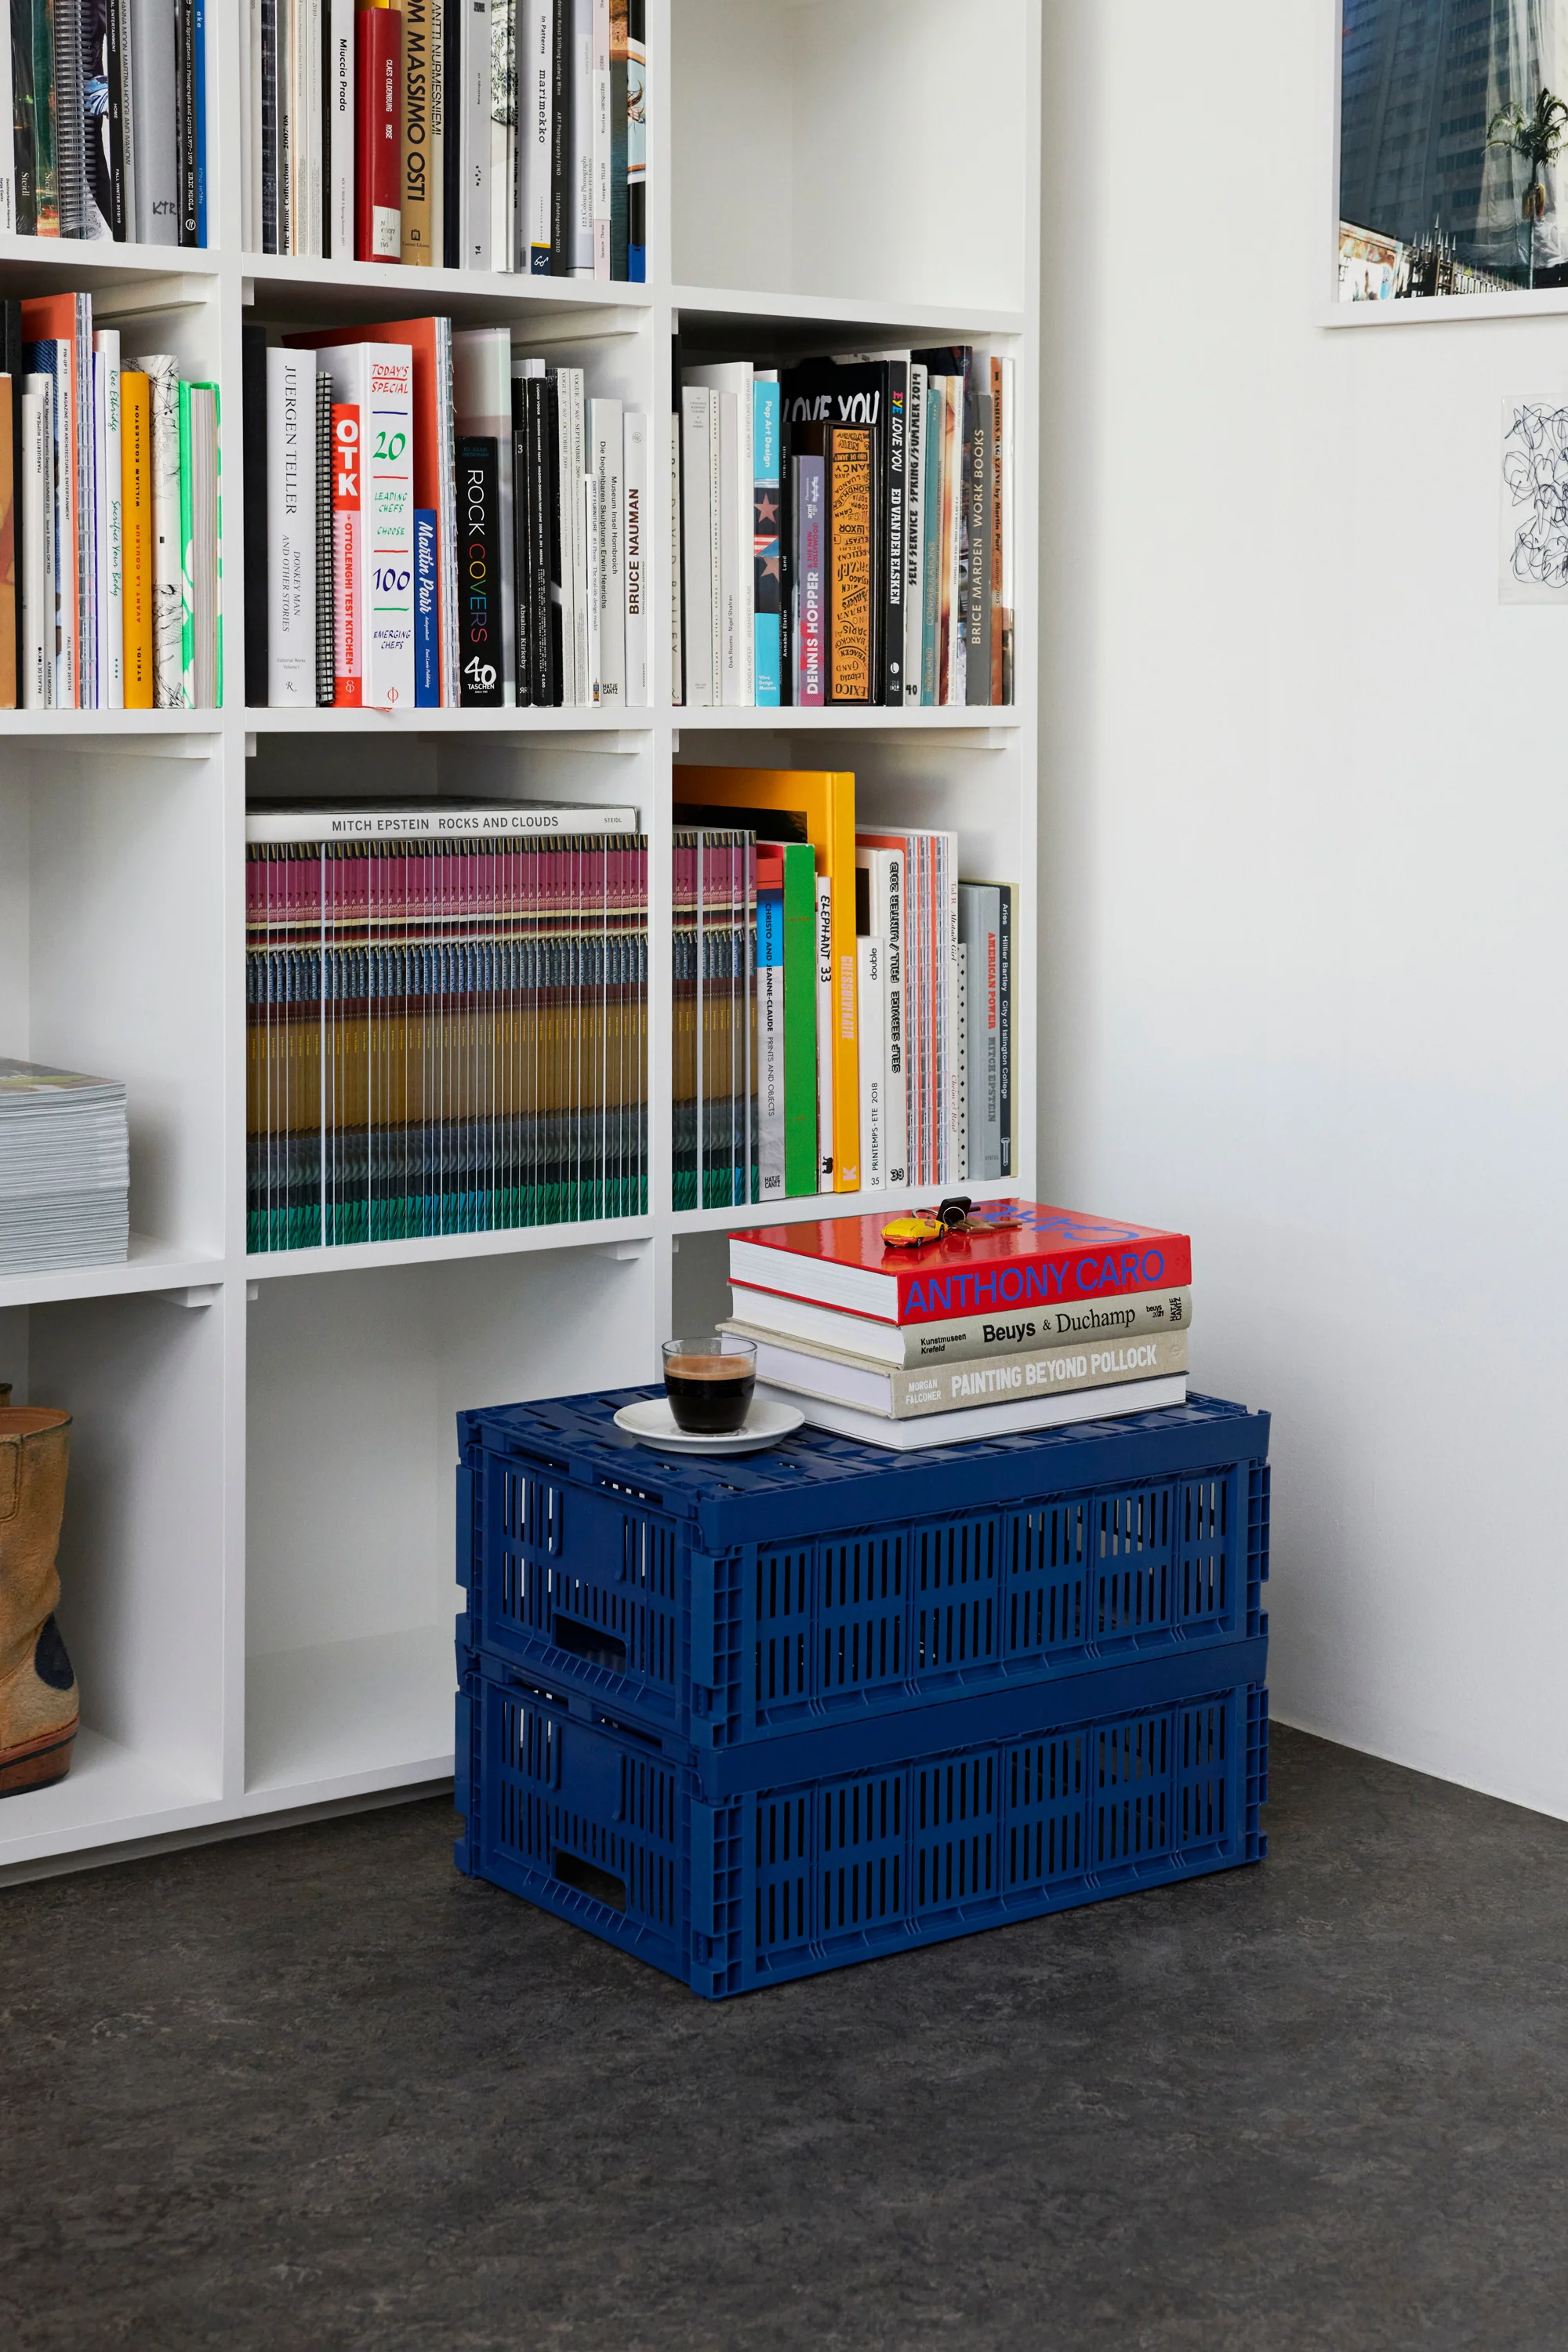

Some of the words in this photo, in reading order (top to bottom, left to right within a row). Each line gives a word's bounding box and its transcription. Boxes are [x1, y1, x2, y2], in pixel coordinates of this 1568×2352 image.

[406, 0, 426, 23] M
[431, 3, 442, 39] ANTTI
[406, 31, 426, 144] MASSIMO
[431, 45, 442, 136] NURMESNIEMI
[539, 69, 547, 143] marimekko
[21, 172, 31, 196] Steidl
[406, 152, 426, 201] OSTI
[152, 201, 177, 216] KTR
[474, 245, 482, 256] 14
[109, 369, 118, 387] Roe
[372, 364, 409, 377] TODAY'S
[372, 382, 408, 394] SPECIAL
[912, 372, 922, 401] 2014
[107, 390, 118, 433] Ethridge
[285, 365, 297, 445] JUERGEN
[763, 401, 772, 418] Pop
[892, 390, 903, 414] EYE
[764, 419, 772, 436] Art
[892, 417, 903, 447] LOVE
[336, 419, 359, 496] OTK
[372, 431, 406, 461] 20
[763, 437, 772, 468] Design
[891, 449, 902, 472] YOU
[909, 402, 920, 503] SPRING/SUMMER
[975, 430, 985, 478] BOOKS
[285, 451, 297, 514] TELLER
[598, 456, 607, 503] begehbaren
[374, 492, 408, 501] LEADING
[379, 503, 404, 513] CHEFS
[467, 470, 485, 536] ROCK
[891, 488, 902, 504] ED
[974, 485, 983, 528] WORK
[109, 500, 121, 543] Sacrifice
[376, 526, 405, 535] CHOOSE
[628, 488, 640, 556] NAUMAN
[891, 506, 901, 530] VAN
[418, 521, 434, 575] Martin
[891, 531, 901, 556] DER
[909, 510, 918, 558] SERVICE
[112, 545, 122, 570] Your
[343, 522, 354, 590] OTTOLENGHI
[972, 538, 982, 599] MARDEN
[109, 572, 122, 597] Body
[136, 575, 141, 586] LA
[372, 568, 411, 592] 100
[890, 557, 900, 605] ELSKEN
[909, 559, 917, 586] SELF
[926, 542, 935, 626] CONFABULATIONS
[419, 578, 435, 615] Parr
[469, 543, 488, 643] COVERS
[629, 561, 640, 615] BRUCE
[807, 572, 819, 633] HOPPER
[344, 592, 354, 615] TEST
[373, 630, 411, 639] EMERGING
[971, 604, 981, 644] BRICE
[344, 617, 354, 666] KITCHEN
[380, 641, 405, 649] CHEFS
[463, 656, 497, 685] 40
[807, 637, 819, 695] DENNIS
[906, 684, 917, 695] 40
[332, 818, 372, 832] MITCH
[377, 818, 430, 831] EPSTEIN
[438, 817, 480, 829] ROCKS
[483, 816, 509, 829] AND
[511, 815, 559, 828] CLOUDS
[820, 895, 831, 960] ELEPHANT
[889, 895, 900, 942] WINTER
[820, 967, 832, 982] 33
[890, 952, 900, 983] FALL
[987, 931, 996, 989] AMERICAN
[891, 991, 901, 1042] SERVICE
[988, 990, 997, 1029] POWER
[1001, 1018, 1008, 1027] of
[891, 1044, 901, 1073] SELF
[988, 1036, 996, 1072] MITCH
[988, 1074, 996, 1123] EPSTEIN
[871, 1177, 880, 1186] 35
[904, 1261, 1069, 1315] ANTHONY
[1076, 1249, 1164, 1291] CARO
[1145, 1304, 1163, 1313] beuys
[1152, 1309, 1164, 1318] 2021
[920, 1333, 967, 1346] Kunstmuseen
[982, 1319, 1036, 1344] Beuys
[1043, 1319, 1052, 1331] &
[1055, 1306, 1136, 1334] Duchamp
[920, 1345, 946, 1355] Krefeld
[908, 1379, 938, 1392] MORGAN
[951, 1366, 1022, 1398] PAINTING
[1025, 1356, 1087, 1385] BEYOND
[1094, 1345, 1157, 1372] POLLOCK
[905, 1391, 942, 1406] FALCONER
